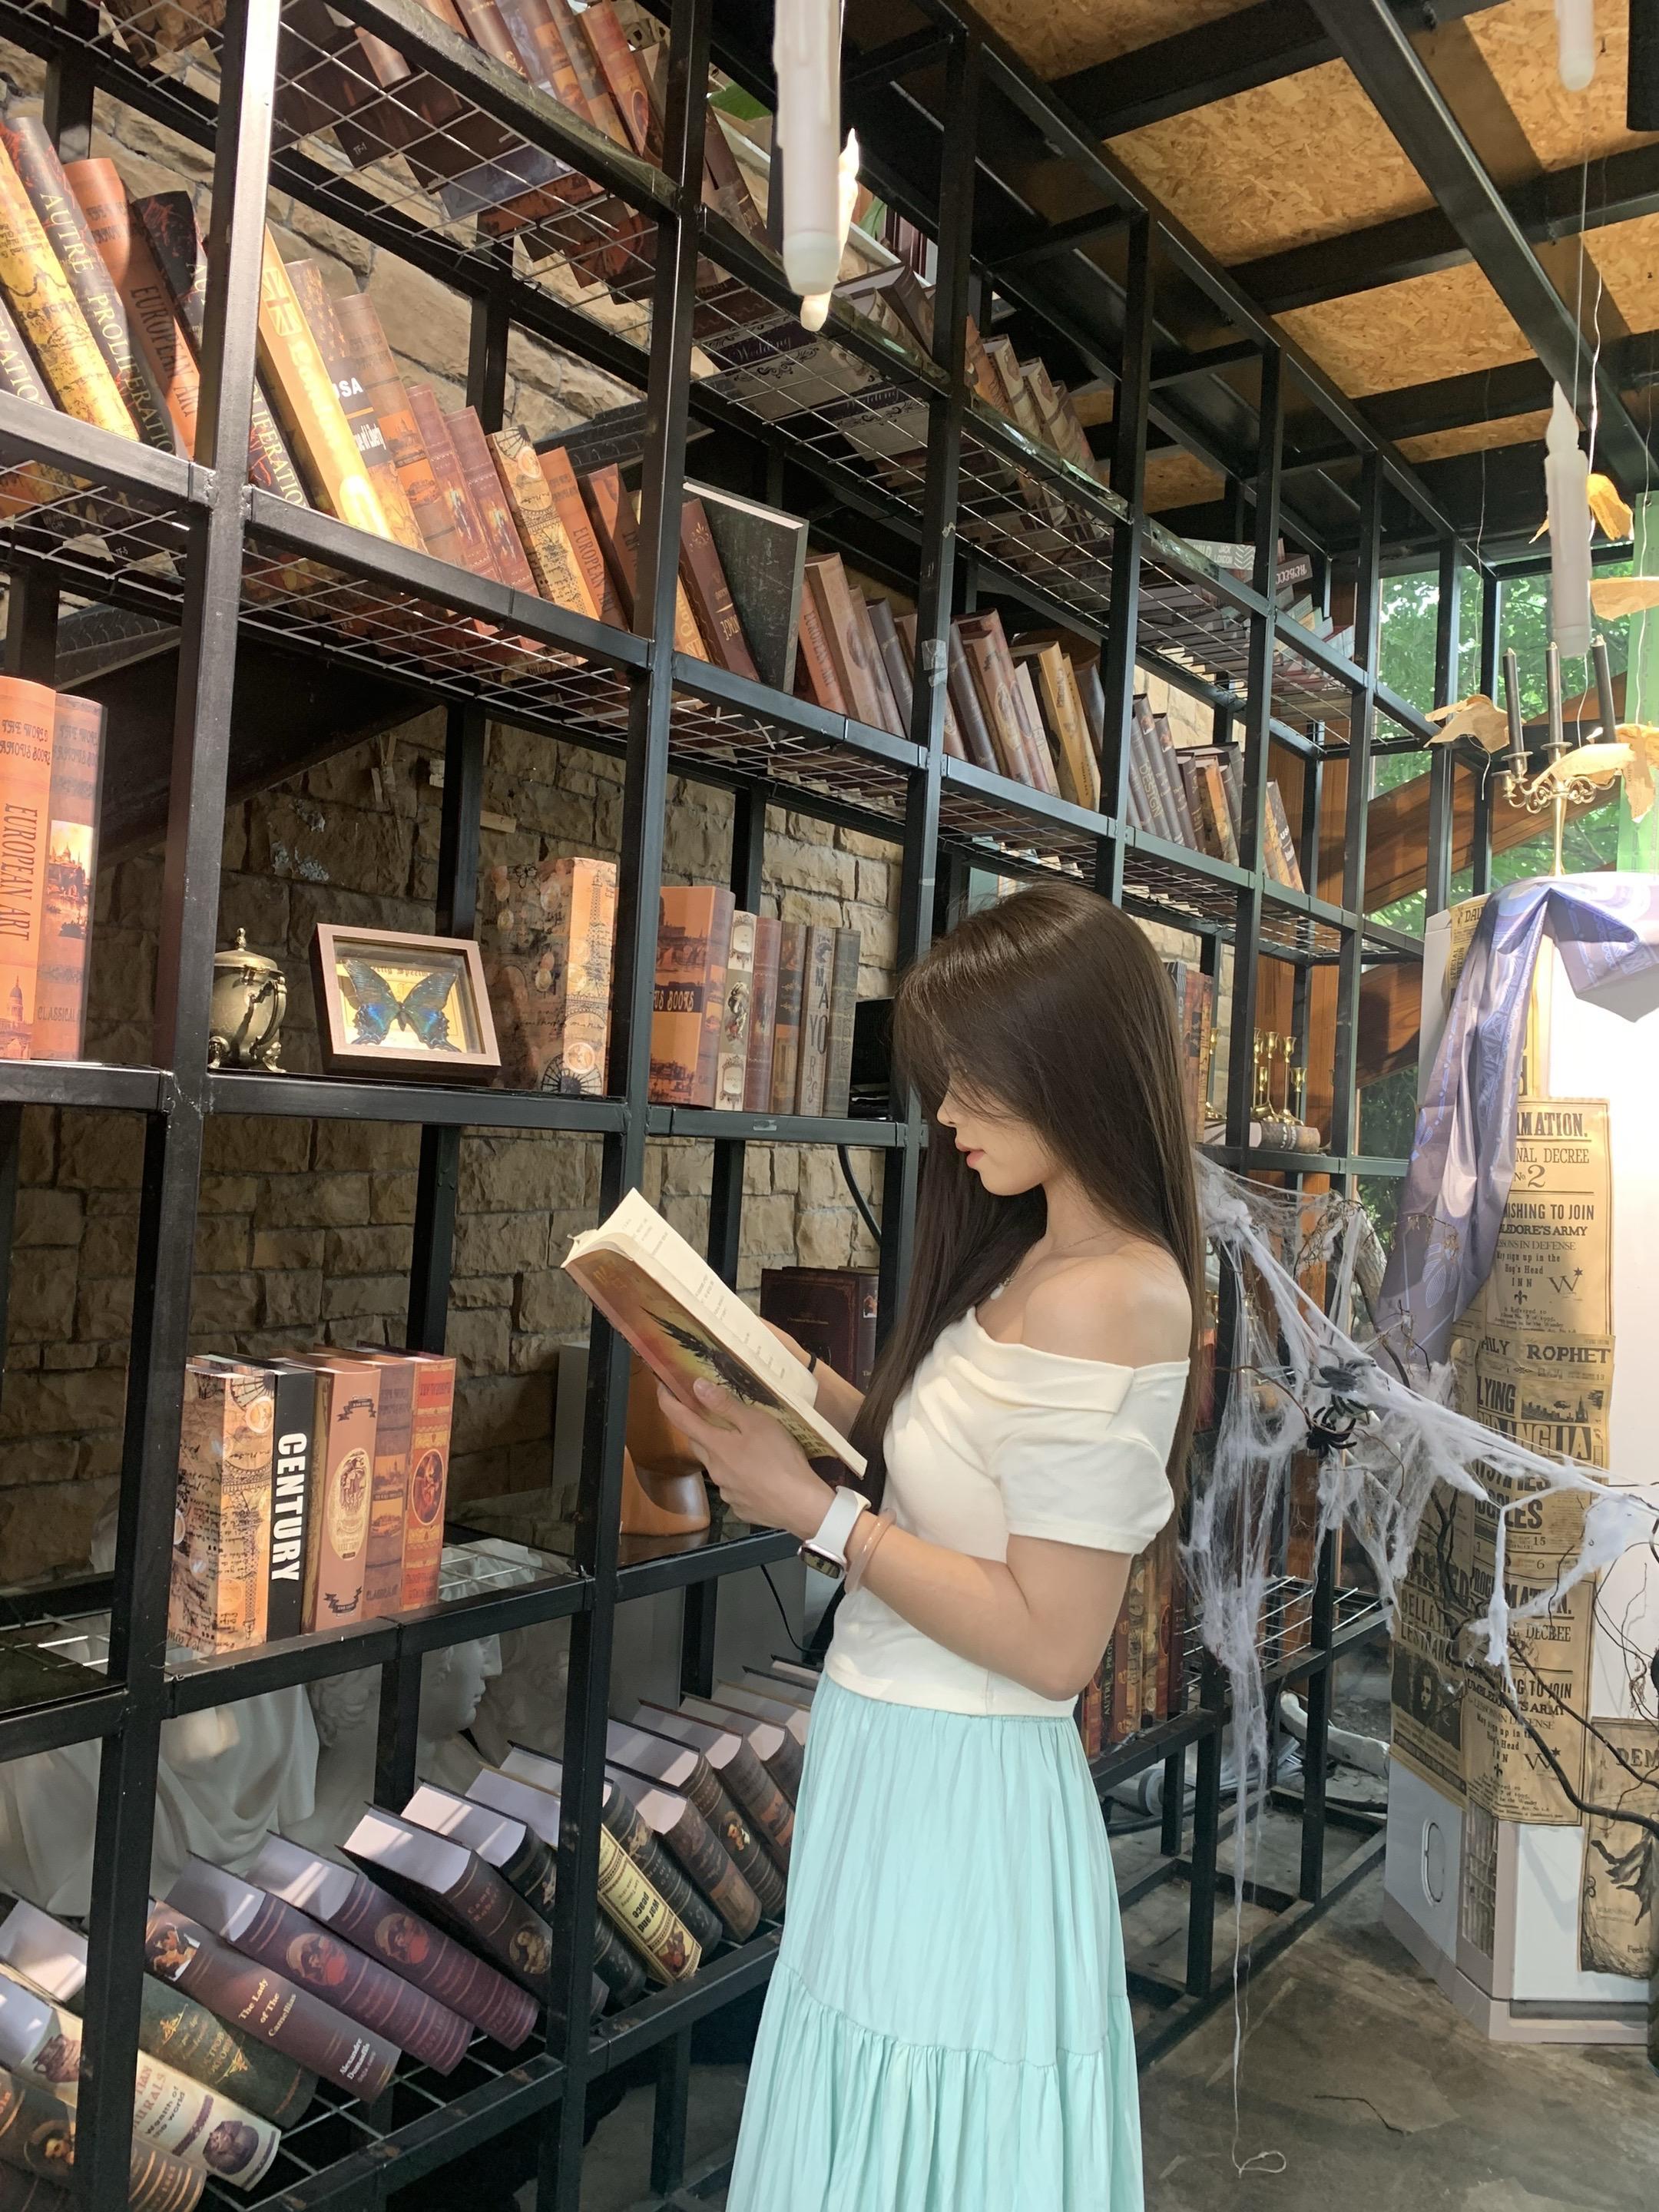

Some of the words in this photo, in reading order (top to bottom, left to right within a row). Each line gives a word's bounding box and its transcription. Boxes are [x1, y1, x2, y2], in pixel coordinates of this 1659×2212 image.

[40, 192, 94, 273] AUTRE
[88, 293, 176, 456] PROLIFERATIO
[130, 286, 194, 378] EUROPEAN
[573, 526, 604, 589] EUROPEAN
[1218, 545, 1231, 554] JACK
[1214, 554, 1233, 565] LONDON
[1138, 763, 1161, 819] DESIGN
[0, 803, 38, 900] EUROPEAN
[0, 902, 31, 942] ART
[1465, 907, 1484, 922] DAI
[667, 990, 694, 1013] BOOKS
[1543, 1147, 1590, 1164] DECREE
[1527, 1164, 1546, 1188] 2
[1550, 1204, 1565, 1220] TO
[1568, 1204, 1594, 1220] JOIN
[1551, 1225, 1588, 1237] ARMY
[1520, 1240, 1532, 1250] IN
[1532, 1240, 1576, 1251] DEFENSE
[1522, 1254, 1532, 1263] up
[1535, 1253, 1544, 1262] in
[1548, 1253, 1561, 1263] the
[1525, 1265, 1544, 1275] Head
[1512, 1277, 1532, 1288] INN
[1546, 1275, 1580, 1293] W
[1476, 1375, 1517, 1415] LYING
[271, 1432, 307, 1581] CENTURY
[1533, 1536, 1546, 1546] 15
[1536, 1559, 1545, 1570] 6
[1530, 1703, 1565, 1716] ARMY
[1512, 1729, 1521, 1738] in
[1501, 1740, 1520, 1751] Head
[632, 1891, 650, 1919] peace
[649, 1899, 661, 1919] War
[637, 1916, 651, 1933] and
[238, 2003, 255, 2020] The
[251, 1978, 269, 2003] Lady
[260, 2011, 270, 2024] of
[267, 1992, 280, 2012] The
[268, 1994, 296, 2037] Camellias
[339, 2038, 363, 2075] Alexandre
[171, 2085, 179, 2098] of
[167, 2091, 186, 2122] world
